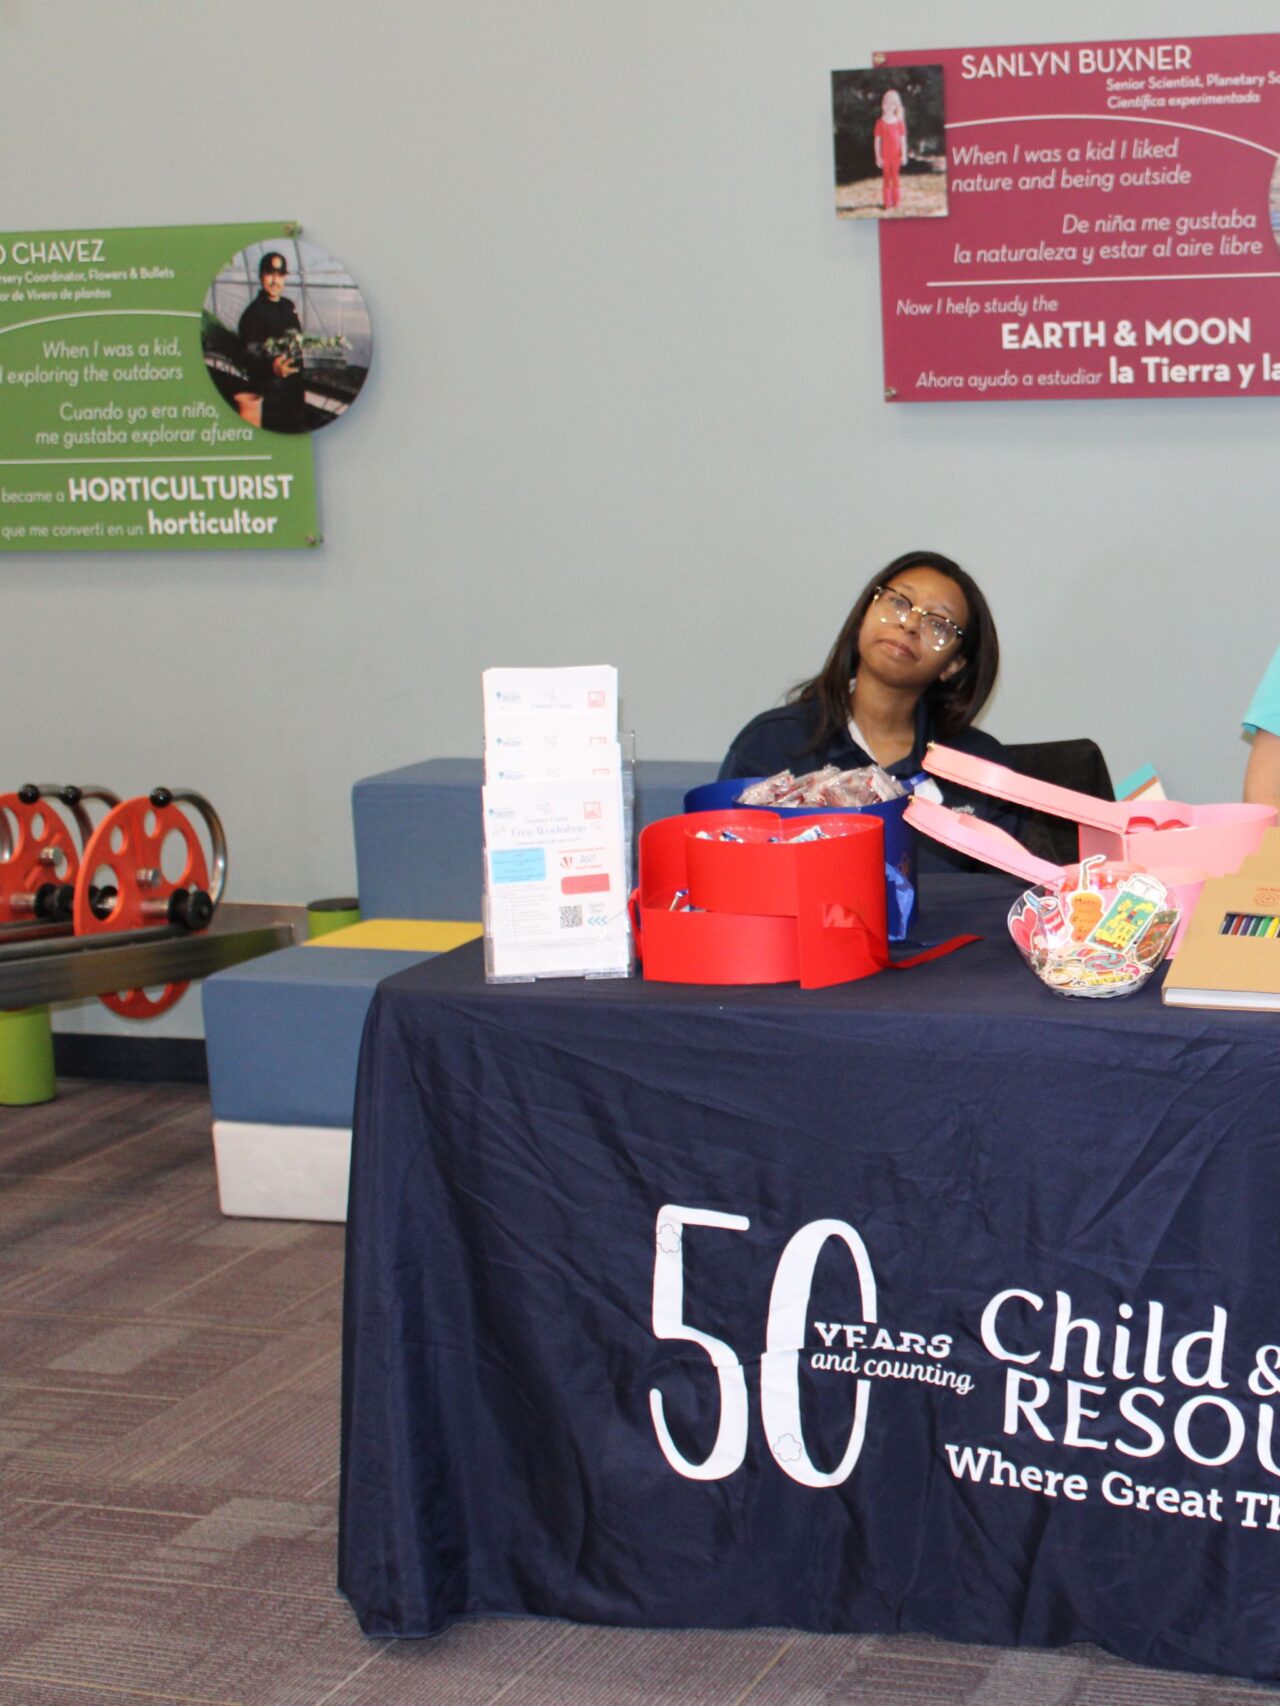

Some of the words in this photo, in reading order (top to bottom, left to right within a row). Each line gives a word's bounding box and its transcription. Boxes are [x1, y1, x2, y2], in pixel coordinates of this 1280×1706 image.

[961, 50, 1070, 79] SANLYN
[1078, 45, 1192, 74] BUXNER
[1106, 78, 1145, 92] Senior
[1148, 76, 1203, 90] Scientist,
[1206, 73, 1264, 88] Planetary
[1168, 91, 1261, 109] experimentada
[952, 144, 1007, 166] When
[1013, 144, 1019, 164] I
[1024, 147, 1061, 163] was
[1067, 147, 1080, 162] a
[1086, 139, 1116, 161] kid
[1121, 140, 1127, 160] I
[1132, 137, 1179, 159] liked
[952, 173, 1013, 192] nature
[1018, 168, 1056, 190] and
[1061, 167, 1114, 192] being
[1120, 164, 1191, 187] outside
[1062, 213, 1089, 234] De
[1095, 213, 1136, 233] niña
[1141, 218, 1170, 232] me
[1176, 208, 1256, 236] gustaba
[12, 239, 106, 265] CHAVEZ
[954, 244, 971, 264] la
[976, 241, 1077, 263] naturaleza
[1082, 247, 1095, 265] y
[1099, 240, 1147, 259] estar
[1153, 237, 1172, 257] al
[1176, 237, 1214, 257] aire
[1219, 235, 1263, 256] libre
[88, 268, 128, 281] Flowers
[129, 267, 138, 280] &
[11, 290, 24, 302] de
[27, 289, 58, 301] Vivero
[60, 289, 73, 300] de
[74, 288, 112, 302] plantas
[897, 299, 932, 315] Now
[937, 298, 942, 314] I
[945, 296, 979, 318] help
[984, 295, 1028, 317] study
[1032, 294, 1058, 312] the
[1001, 320, 1106, 350] EARTH
[1113, 320, 1138, 347] &
[1145, 317, 1251, 346] MOON
[43, 342, 89, 359] When
[94, 341, 98, 357] I
[103, 345, 133, 357] was
[138, 344, 149, 357] a
[7, 365, 79, 387] exploring
[83, 364, 108, 382] the
[112, 362, 184, 381] outdoors
[916, 371, 963, 388] Ahora
[968, 369, 1017, 391] ayudo
[1023, 373, 1032, 386] a
[1038, 367, 1103, 387] estudiar
[1109, 356, 1134, 385] la
[1141, 356, 1231, 384] Tierra
[1237, 363, 1255, 389] y
[60, 400, 123, 421] Cuando
[128, 406, 147, 424] yo
[152, 405, 177, 419] era
[36, 431, 59, 445] me
[63, 428, 127, 449] gustaba
[131, 425, 196, 447] explorar
[201, 422, 252, 445] afuera
[2, 488, 52, 503] became
[55, 491, 65, 502] a
[69, 475, 293, 502] HORTICULTURIST
[2, 526, 26, 541] que
[29, 526, 49, 537] me
[107, 525, 123, 537] en
[127, 525, 144, 536] un
[148, 508, 277, 535] horticultor
[650, 1203, 877, 1488] 50
[980, 1288, 1229, 1389] Child
[811, 1351, 860, 1375] and
[863, 1357, 975, 1395] counting
[945, 1444, 1088, 1501] Where
[1101, 1471, 1223, 1521] Great
